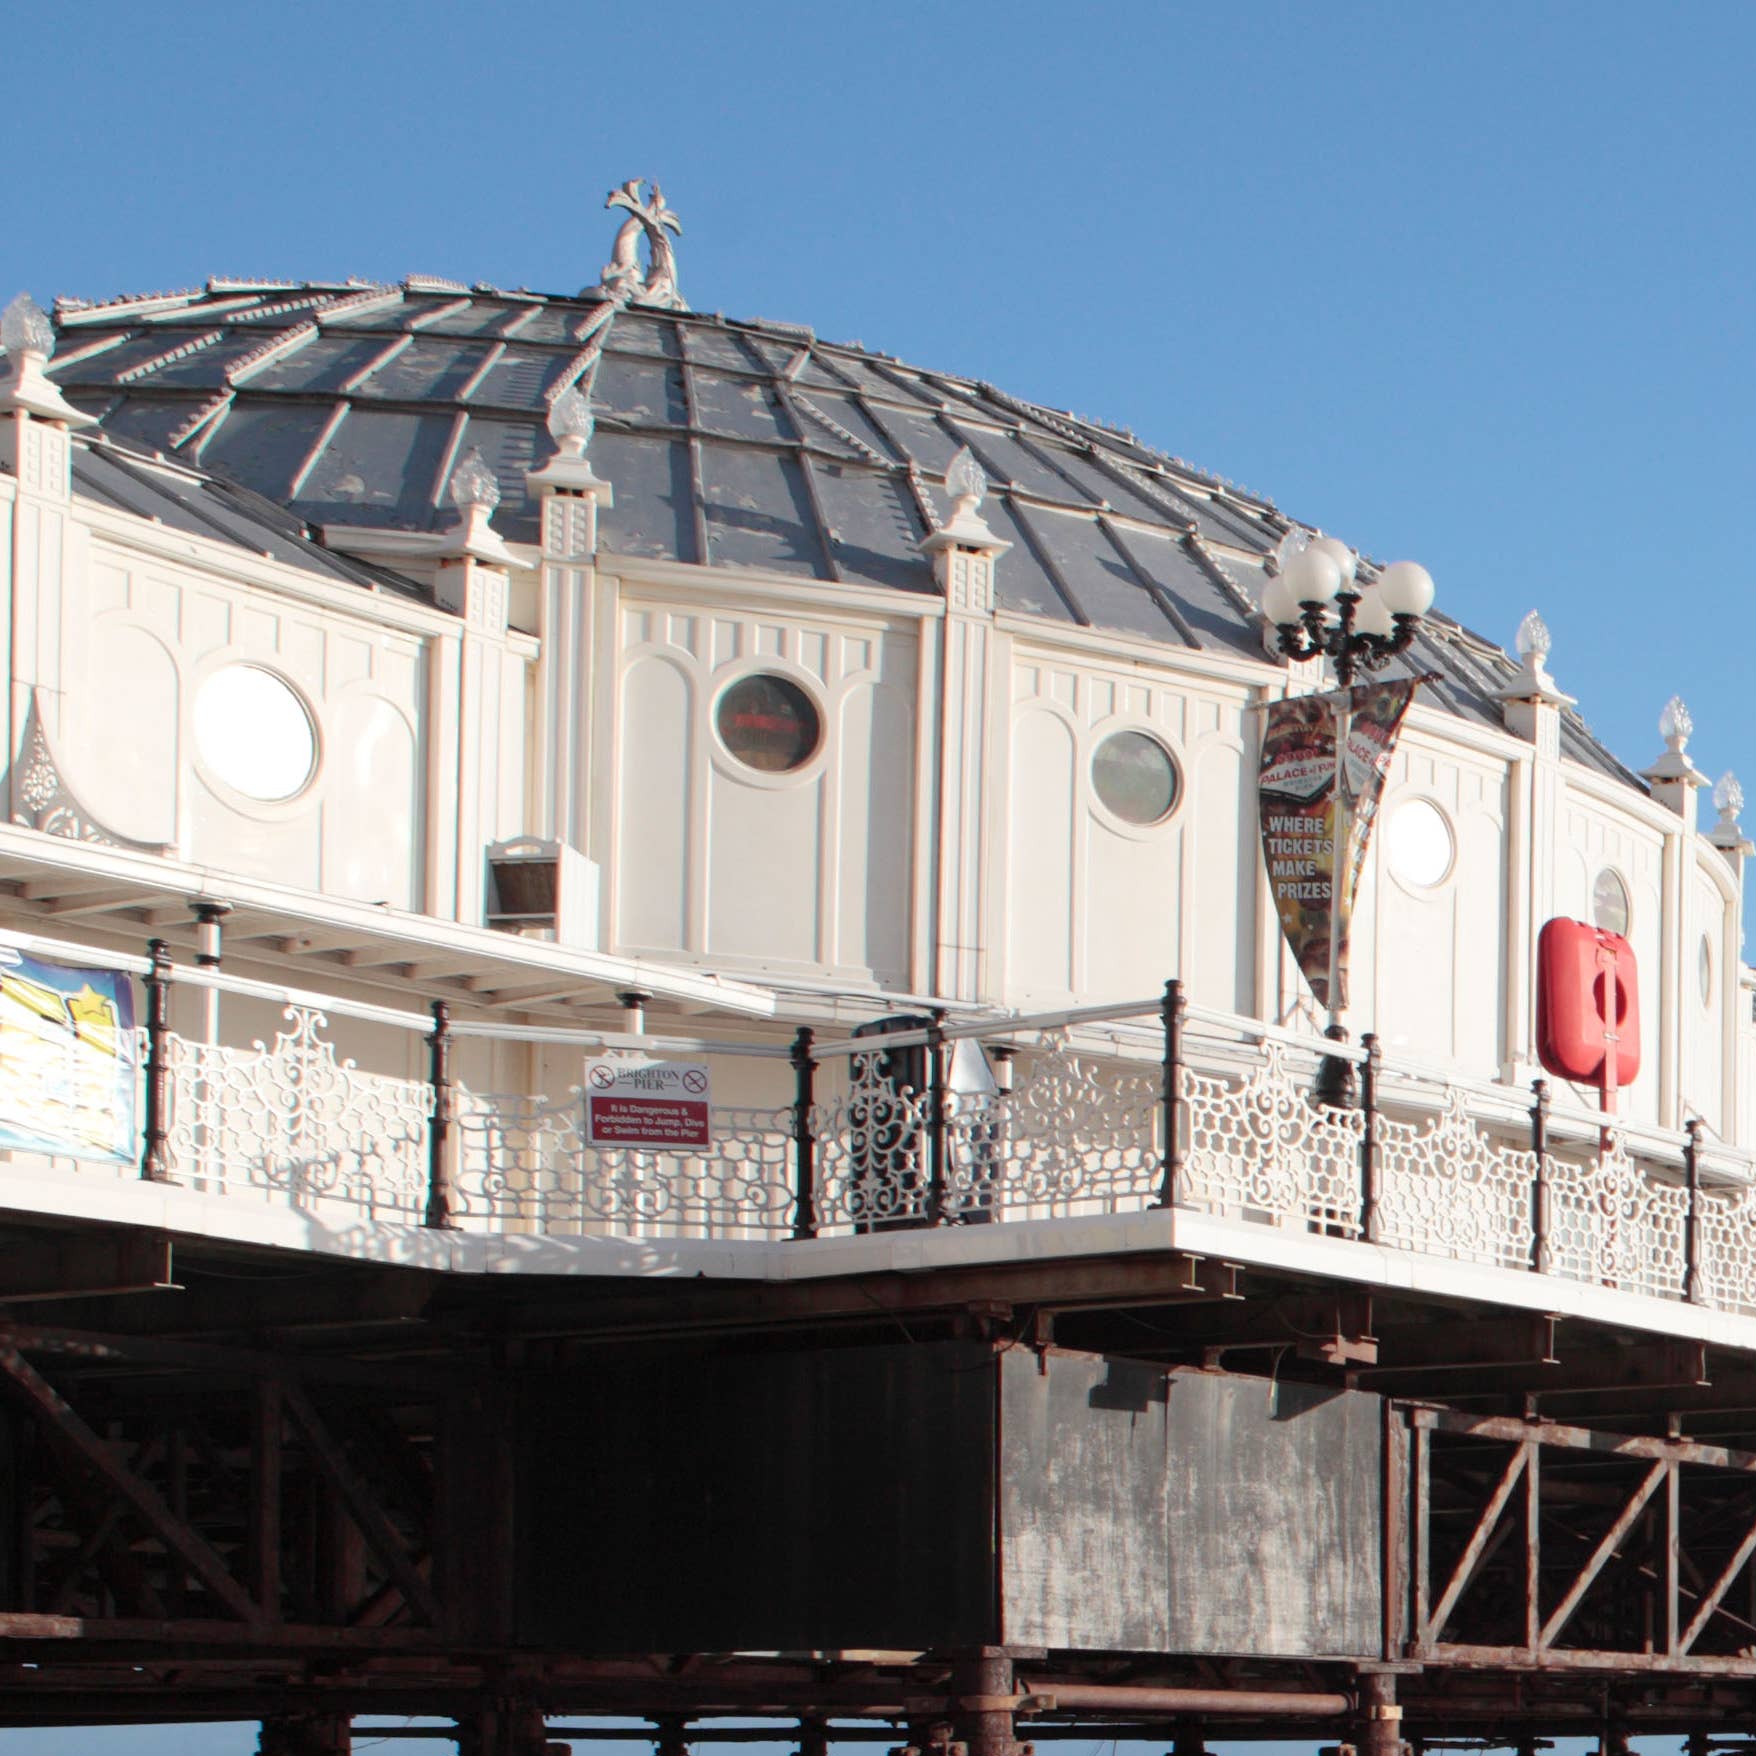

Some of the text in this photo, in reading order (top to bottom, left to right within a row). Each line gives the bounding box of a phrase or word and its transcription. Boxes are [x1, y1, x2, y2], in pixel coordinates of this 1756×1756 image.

[1260, 767, 1307, 784] PALACE
[1269, 816, 1324, 834] WHERE
[1268, 838, 1334, 855] TICKETS
[1273, 860, 1316, 877] MAKE
[1277, 882, 1332, 899] PRIZES
[618, 1068, 679, 1080] BRIGHTON
[634, 1078, 664, 1090] PIER
[611, 1104, 689, 1116] It is Dangerous &
[595, 1114, 641, 1124] Forbidden
[643, 1116, 654, 1125] to
[684, 1118, 705, 1128] Dive
[614, 1125, 640, 1135] Swim
[641, 1127, 663, 1136] from
[664, 1128, 679, 1137] the
[681, 1129, 699, 1137] Pier
